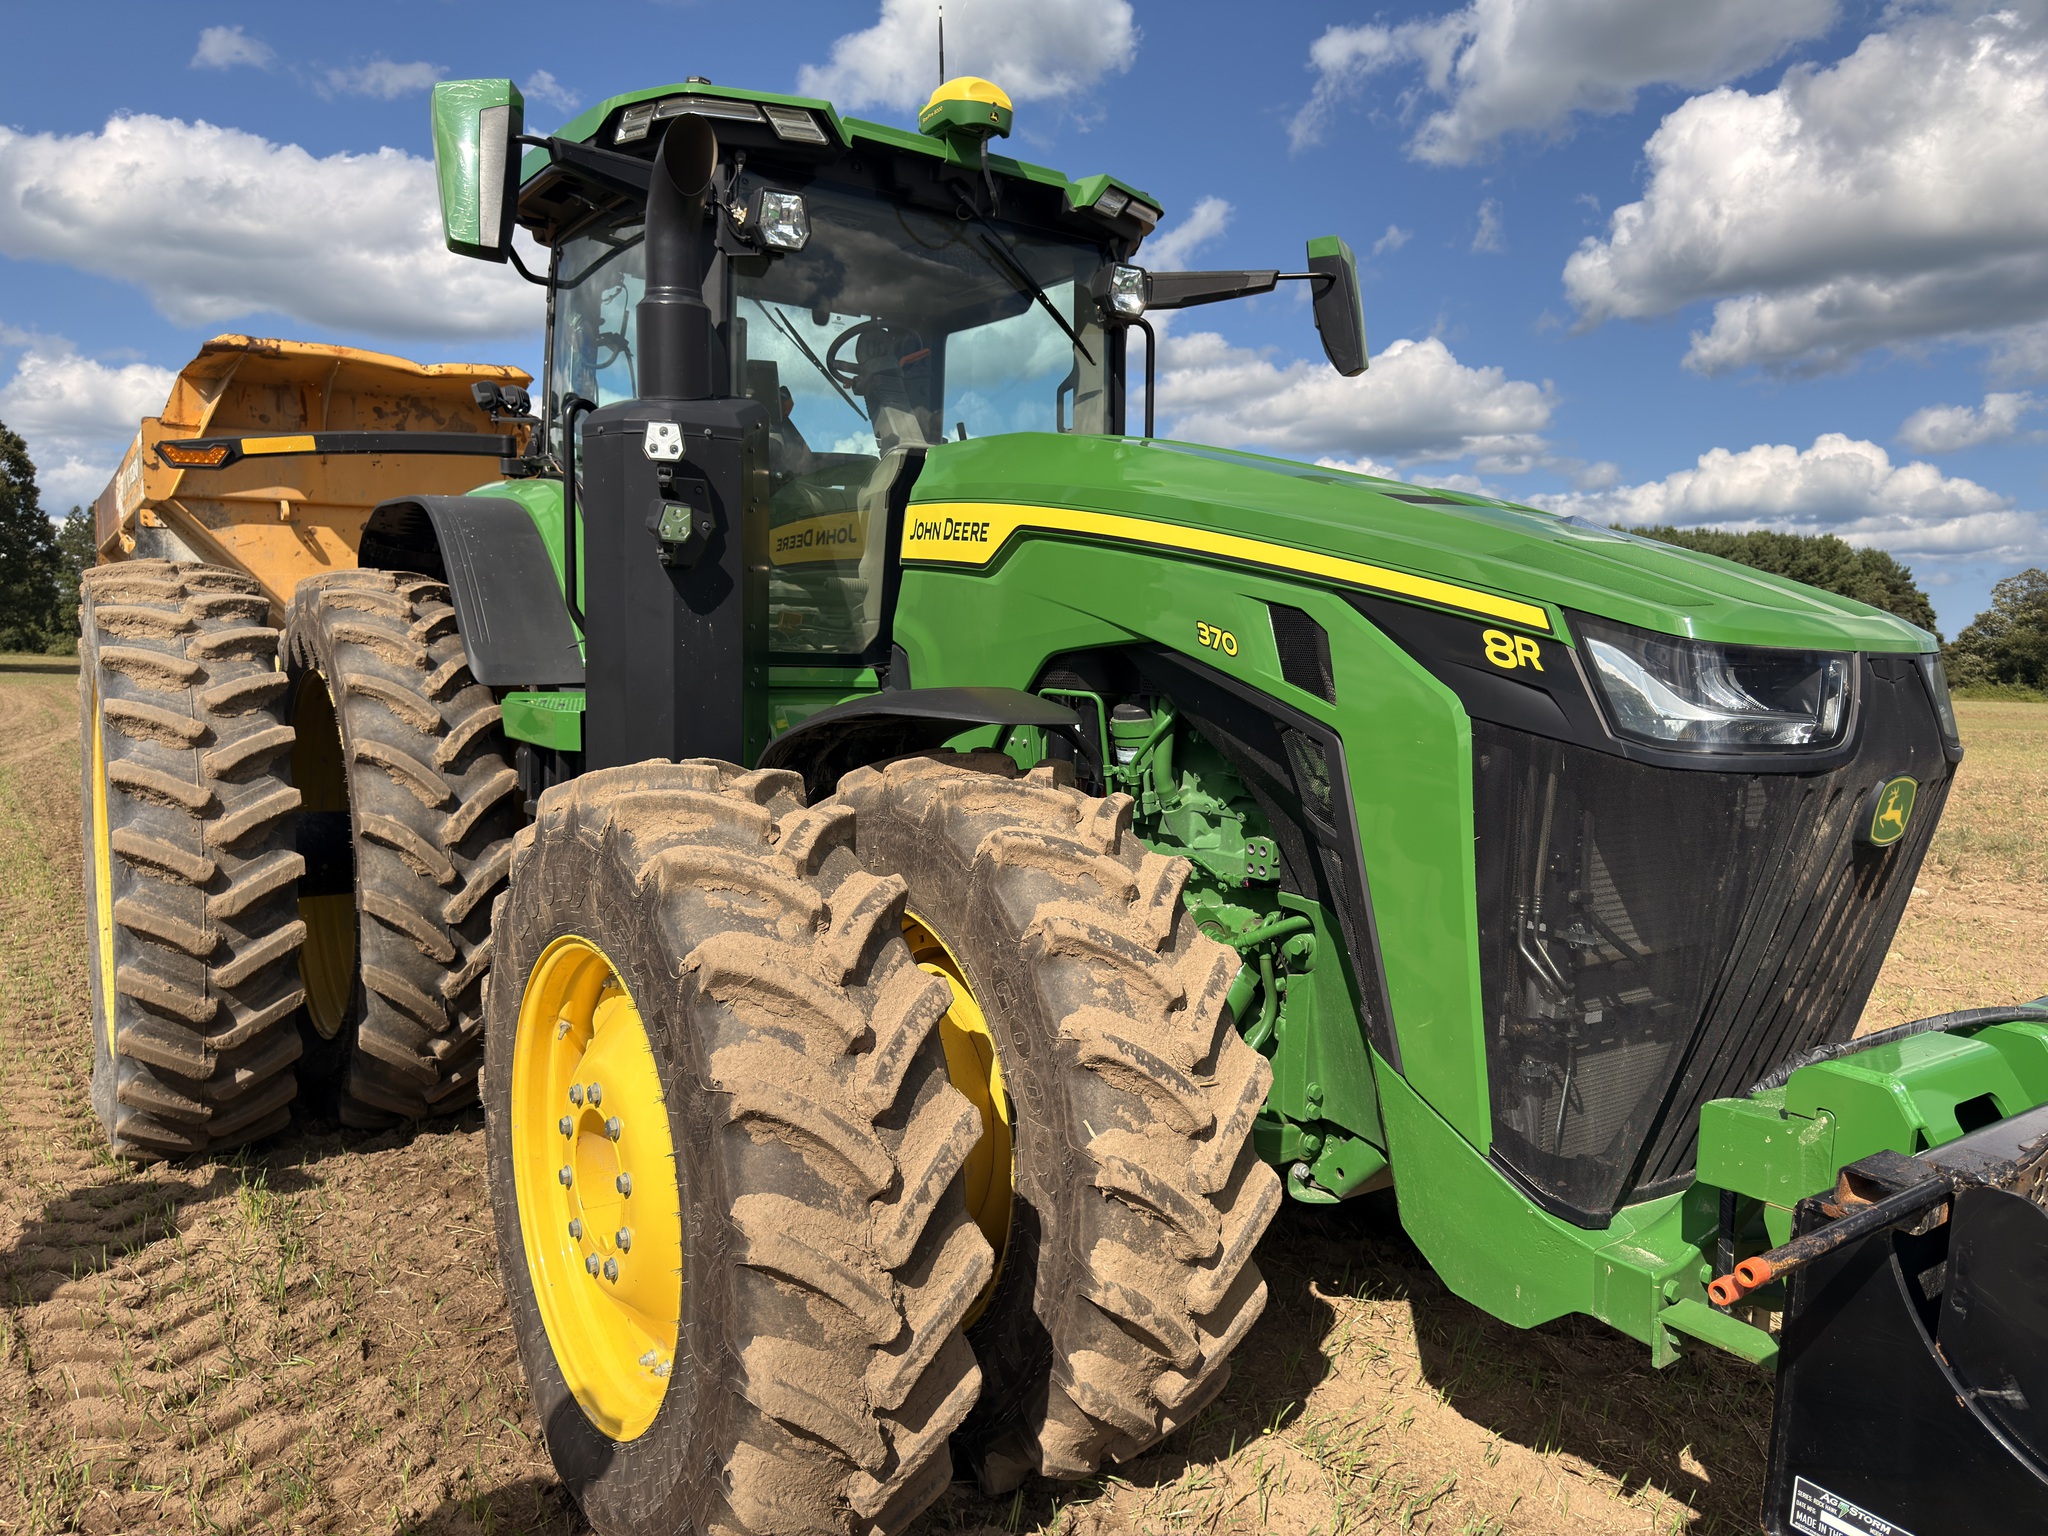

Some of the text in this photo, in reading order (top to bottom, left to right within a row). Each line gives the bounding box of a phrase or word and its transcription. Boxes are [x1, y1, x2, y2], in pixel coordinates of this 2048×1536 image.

[909, 517, 990, 542] JOHN DEERE
[1196, 620, 1238, 657] 370
[1482, 629, 1545, 672] 8R
[1795, 1499, 1807, 1509] DATE
[1797, 1489, 1838, 1515] SERIES: ROCK HAWK
[1796, 1510, 1818, 1529] MADE
[1818, 1522, 1827, 1535] IN
[1848, 1506, 1892, 1535] STORM
